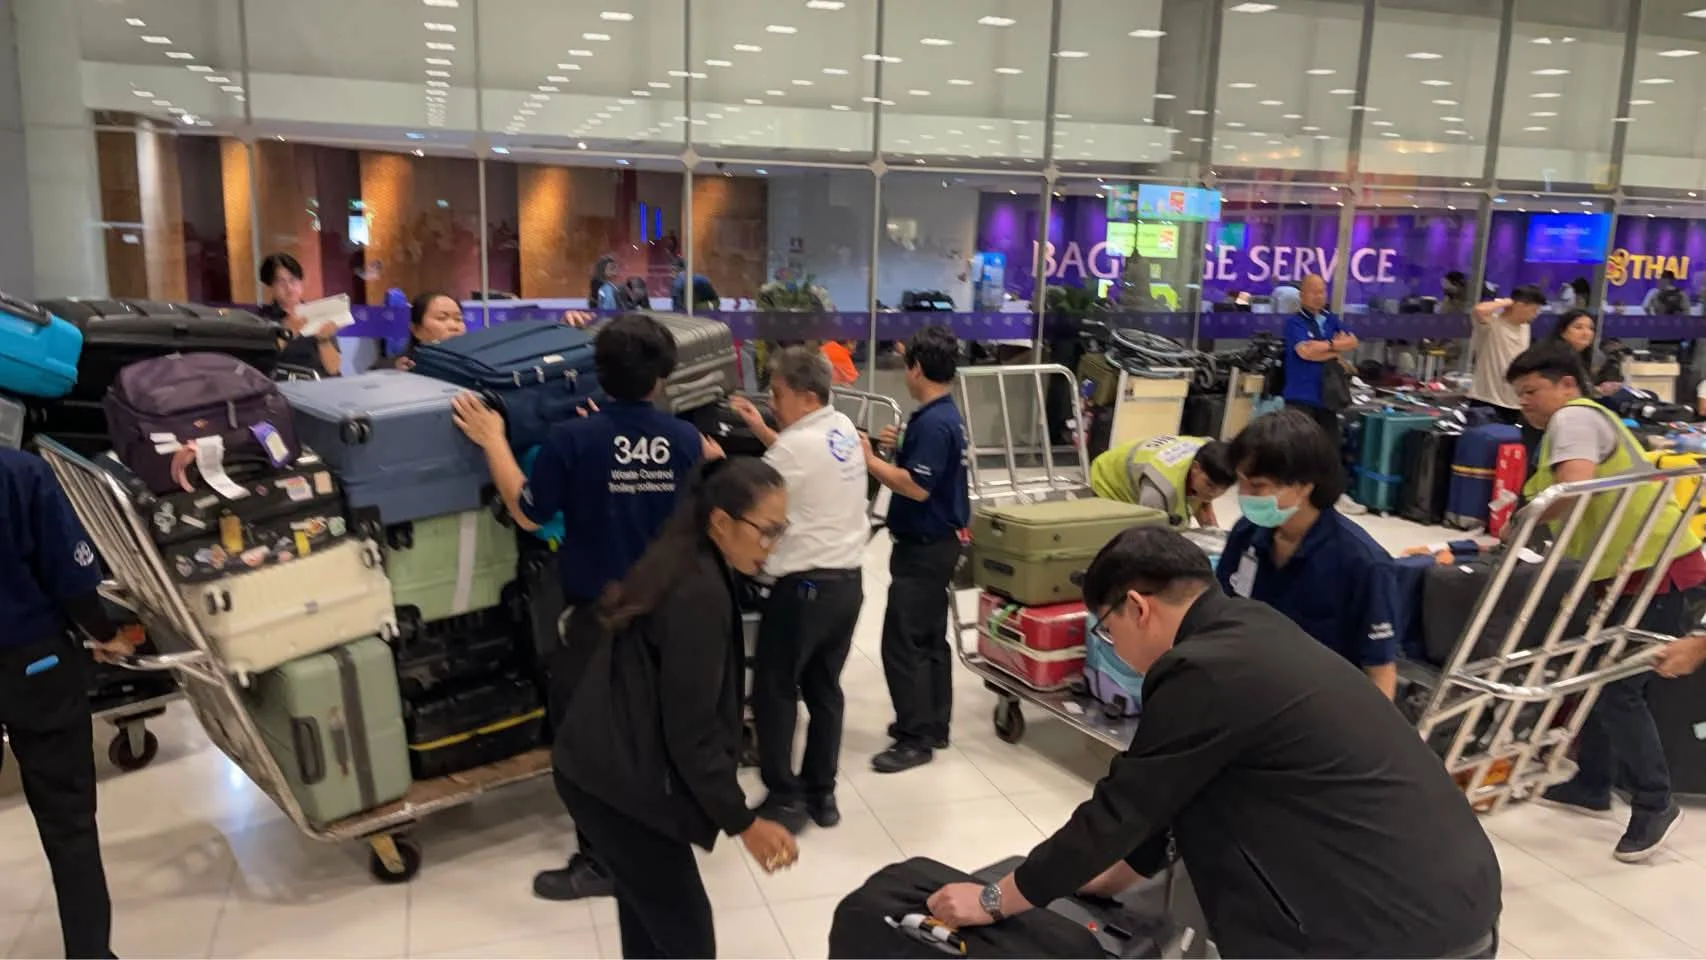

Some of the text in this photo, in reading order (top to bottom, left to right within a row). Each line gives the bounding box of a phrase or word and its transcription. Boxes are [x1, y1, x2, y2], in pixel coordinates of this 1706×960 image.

[1031, 240, 1238, 281] BAGE
[1247, 245, 1397, 283] SERVCE
[1629, 255, 1690, 280] THAI
[613, 435, 671, 465] 346
[639, 468, 674, 480] Control
